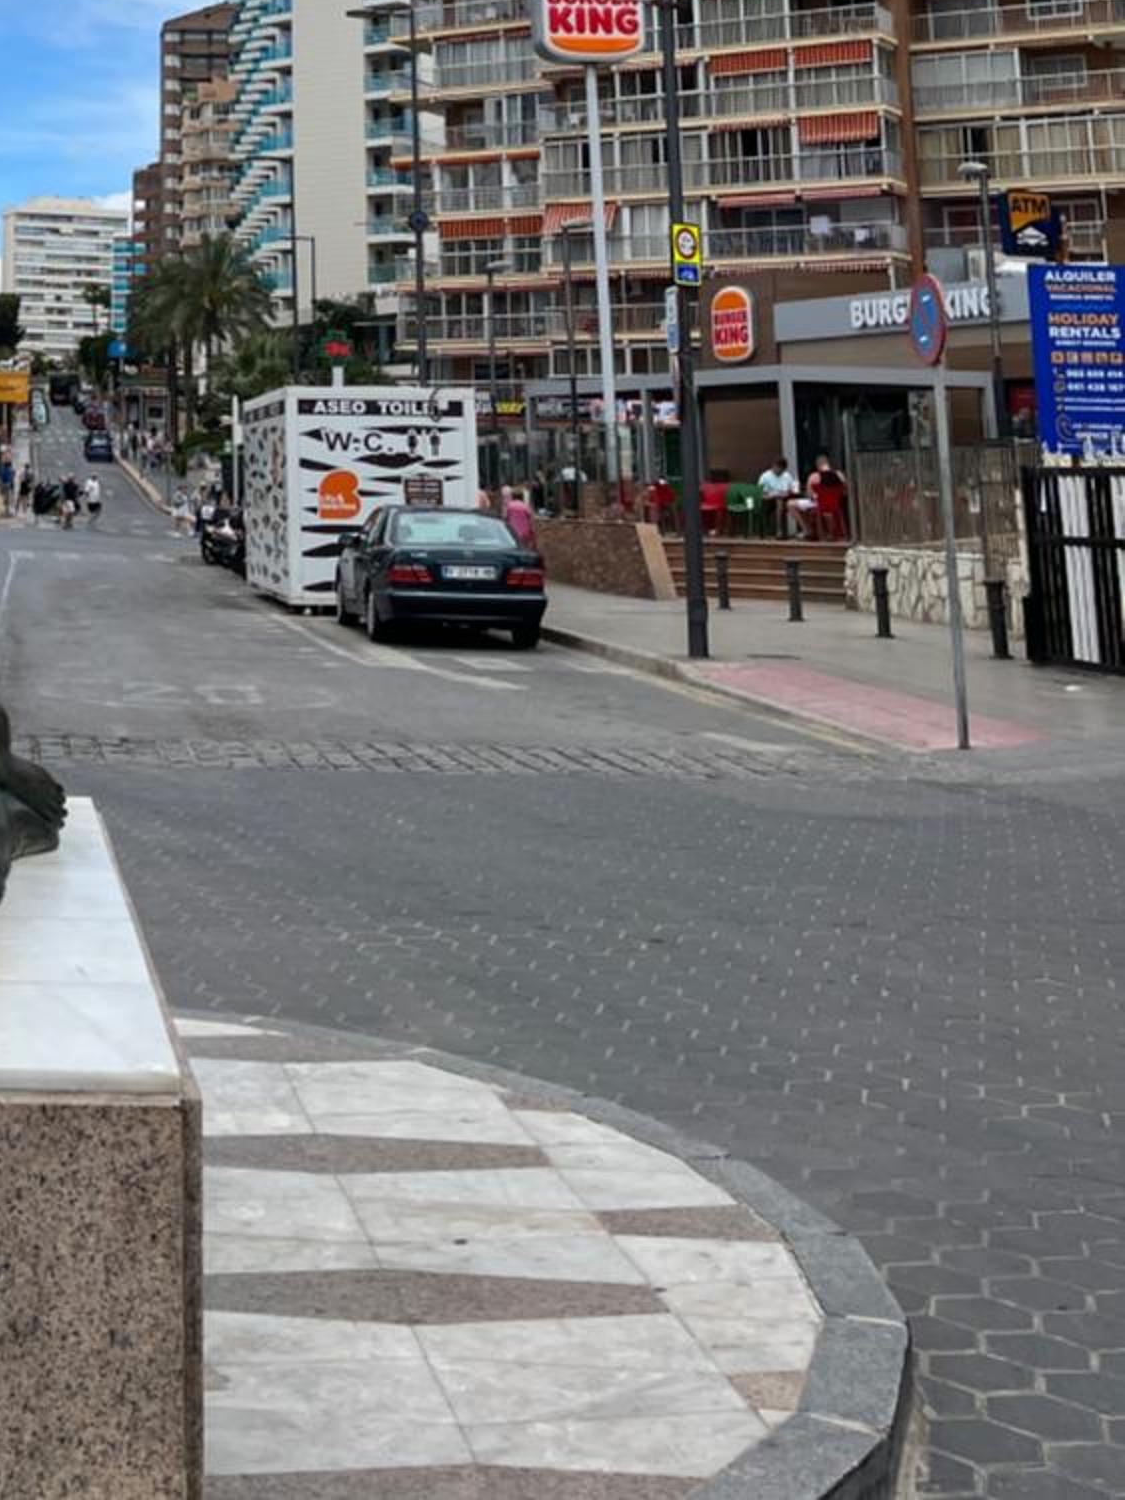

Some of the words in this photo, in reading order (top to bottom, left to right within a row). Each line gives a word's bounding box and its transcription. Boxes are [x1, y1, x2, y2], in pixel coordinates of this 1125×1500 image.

[549, 6, 640, 35] KING
[1011, 196, 1049, 213] ATM
[1045, 270, 1116, 282] ALQUILER
[849, 294, 911, 328] BURG
[1048, 313, 1118, 324] HOLIDAY
[714, 325, 748, 345] KING
[1049, 327, 1121, 339] RENTALS
[314, 400, 366, 414] ASEO
